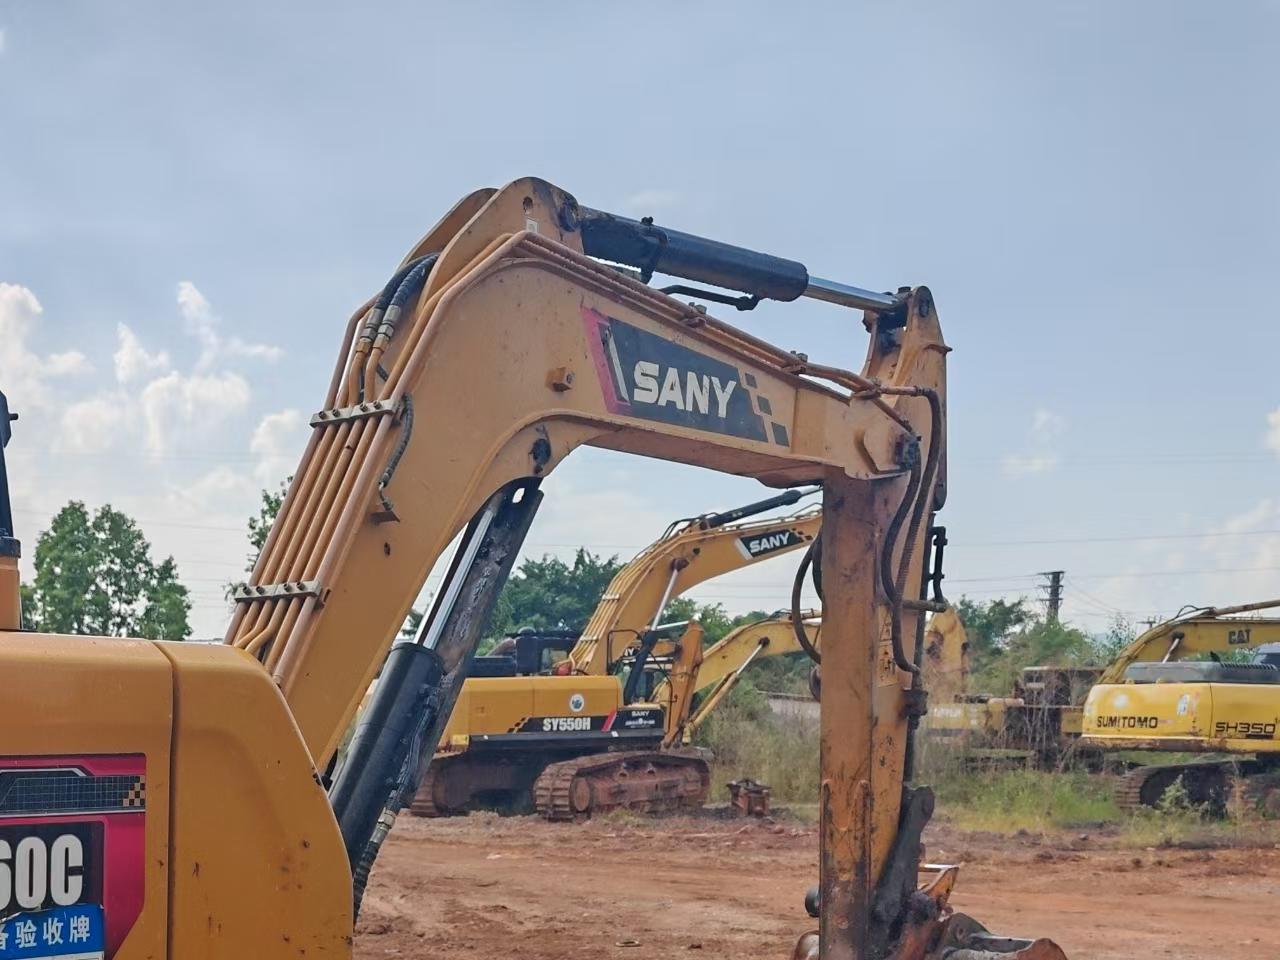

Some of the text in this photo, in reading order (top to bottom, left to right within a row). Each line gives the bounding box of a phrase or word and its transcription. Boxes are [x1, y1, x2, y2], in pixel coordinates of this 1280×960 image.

[633, 360, 737, 418] SANY
[749, 532, 789, 553] SANY
[1228, 629, 1252, 645] CAT
[543, 717, 591, 731] SY550H
[1096, 716, 1158, 729] SUMITOMO
[1215, 721, 1276, 734] SH350
